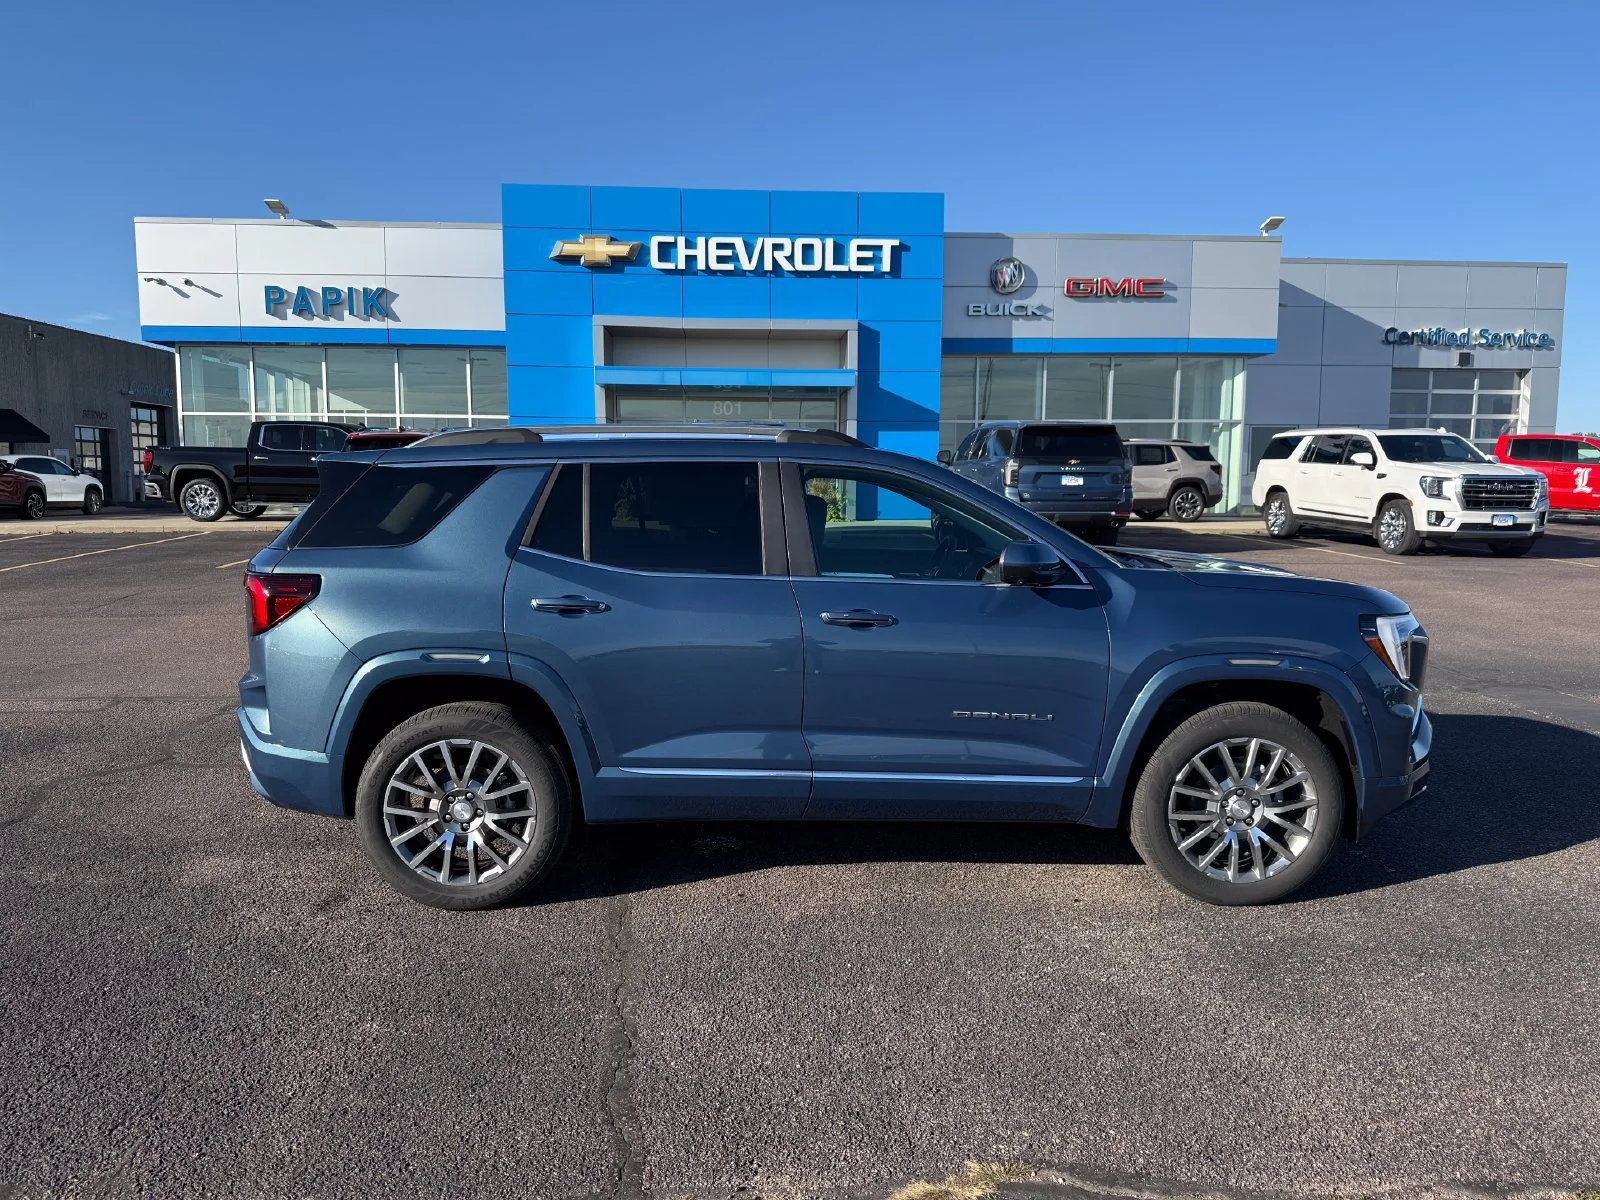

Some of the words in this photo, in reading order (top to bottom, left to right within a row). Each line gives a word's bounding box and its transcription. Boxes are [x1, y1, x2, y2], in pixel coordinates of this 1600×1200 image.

[650, 235, 900, 273] CHEVROLET
[1064, 277, 1167, 298] GMC
[264, 285, 388, 318] PAPIK
[968, 302, 1045, 317] BUICK
[1384, 327, 1471, 347] Certified
[1478, 328, 1552, 347] Service
[711, 400, 742, 416] 801
[952, 710, 1054, 721] DENALI
